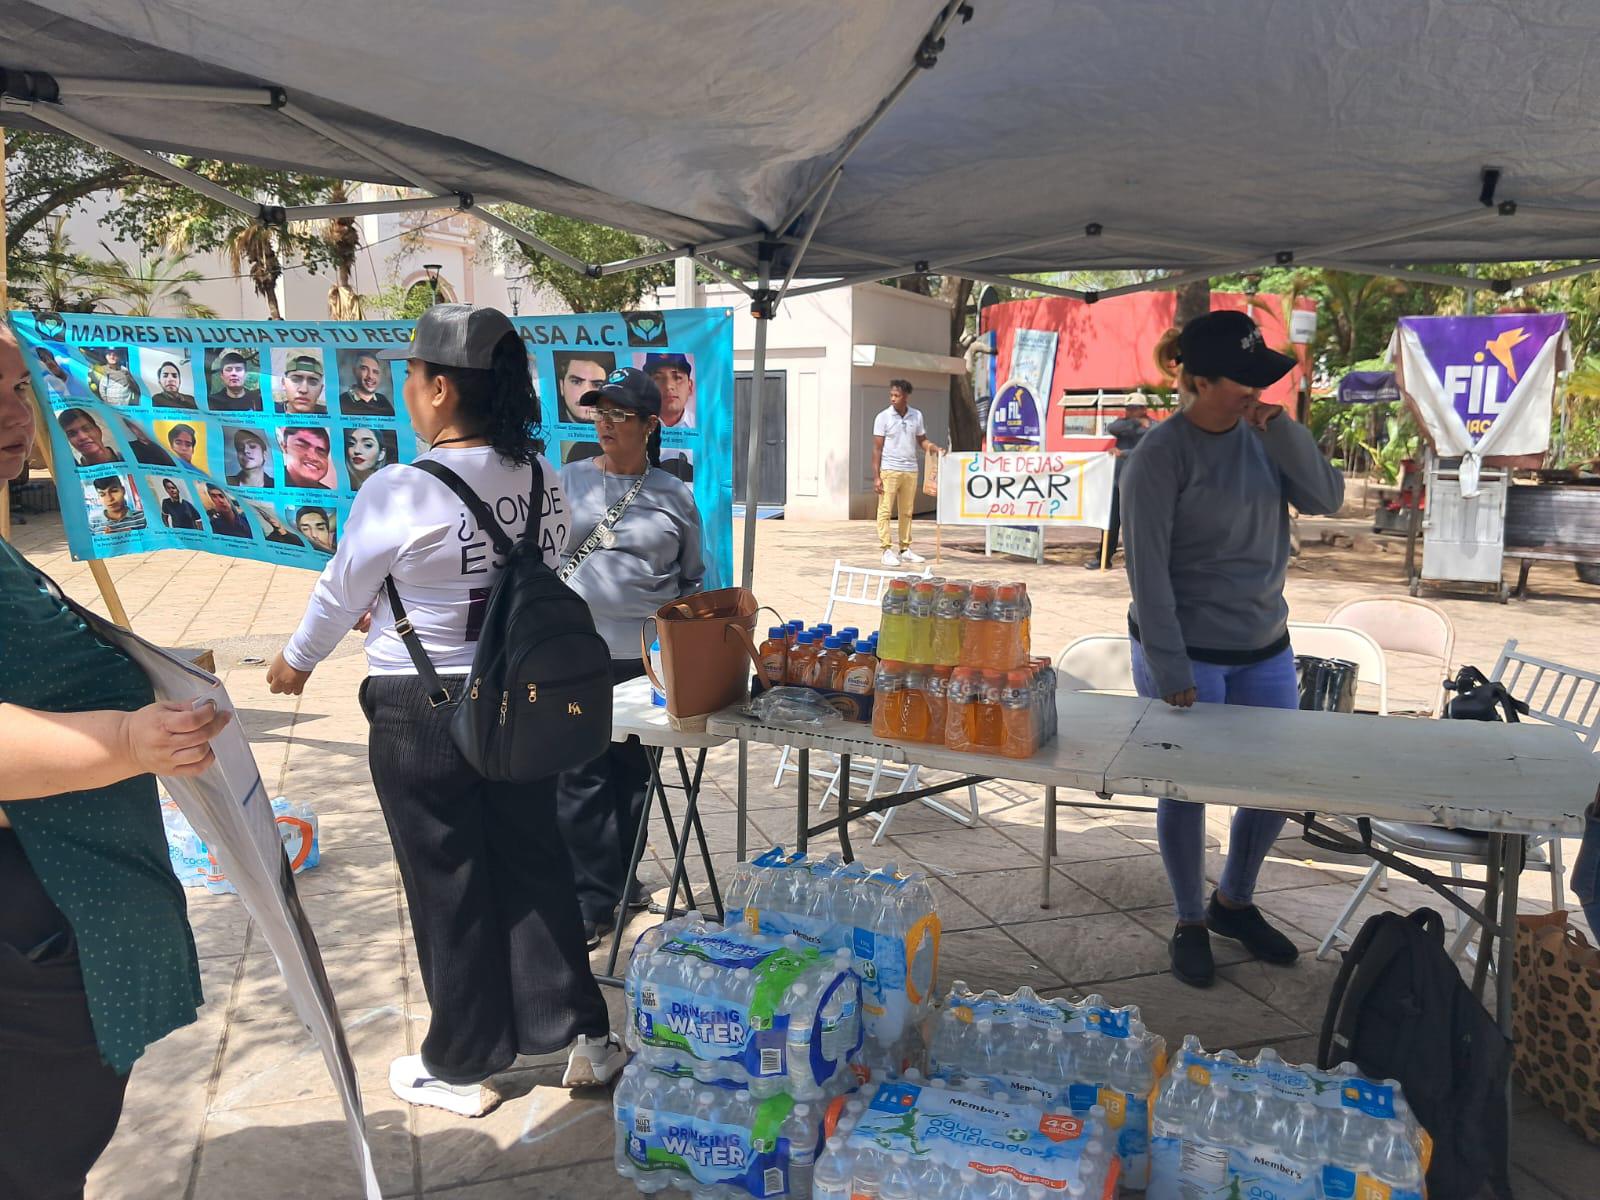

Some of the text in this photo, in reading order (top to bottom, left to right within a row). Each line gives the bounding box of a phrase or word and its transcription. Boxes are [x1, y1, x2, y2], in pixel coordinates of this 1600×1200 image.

[71, 324, 160, 343] MADRES
[162, 326, 194, 343] EN
[196, 327, 274, 344] LUCHA
[274, 328, 325, 343] POR
[325, 328, 359, 343] TU
[518, 325, 568, 345] ASA
[575, 325, 623, 346] A.C.
[1015, 455, 1065, 473] DEJAS
[966, 473, 1071, 501] ORAR
[986, 502, 1016, 518] por
[461, 523, 567, 576] EA?
[665, 1013, 748, 1045] WATER
[949, 1098, 1011, 1119] Member's
[1103, 1099, 1121, 1114] 18
[929, 1118, 983, 1136] agua
[661, 1136, 746, 1168] WATER
[925, 1126, 1034, 1157] purificada
[1253, 1156, 1302, 1180] Member's
